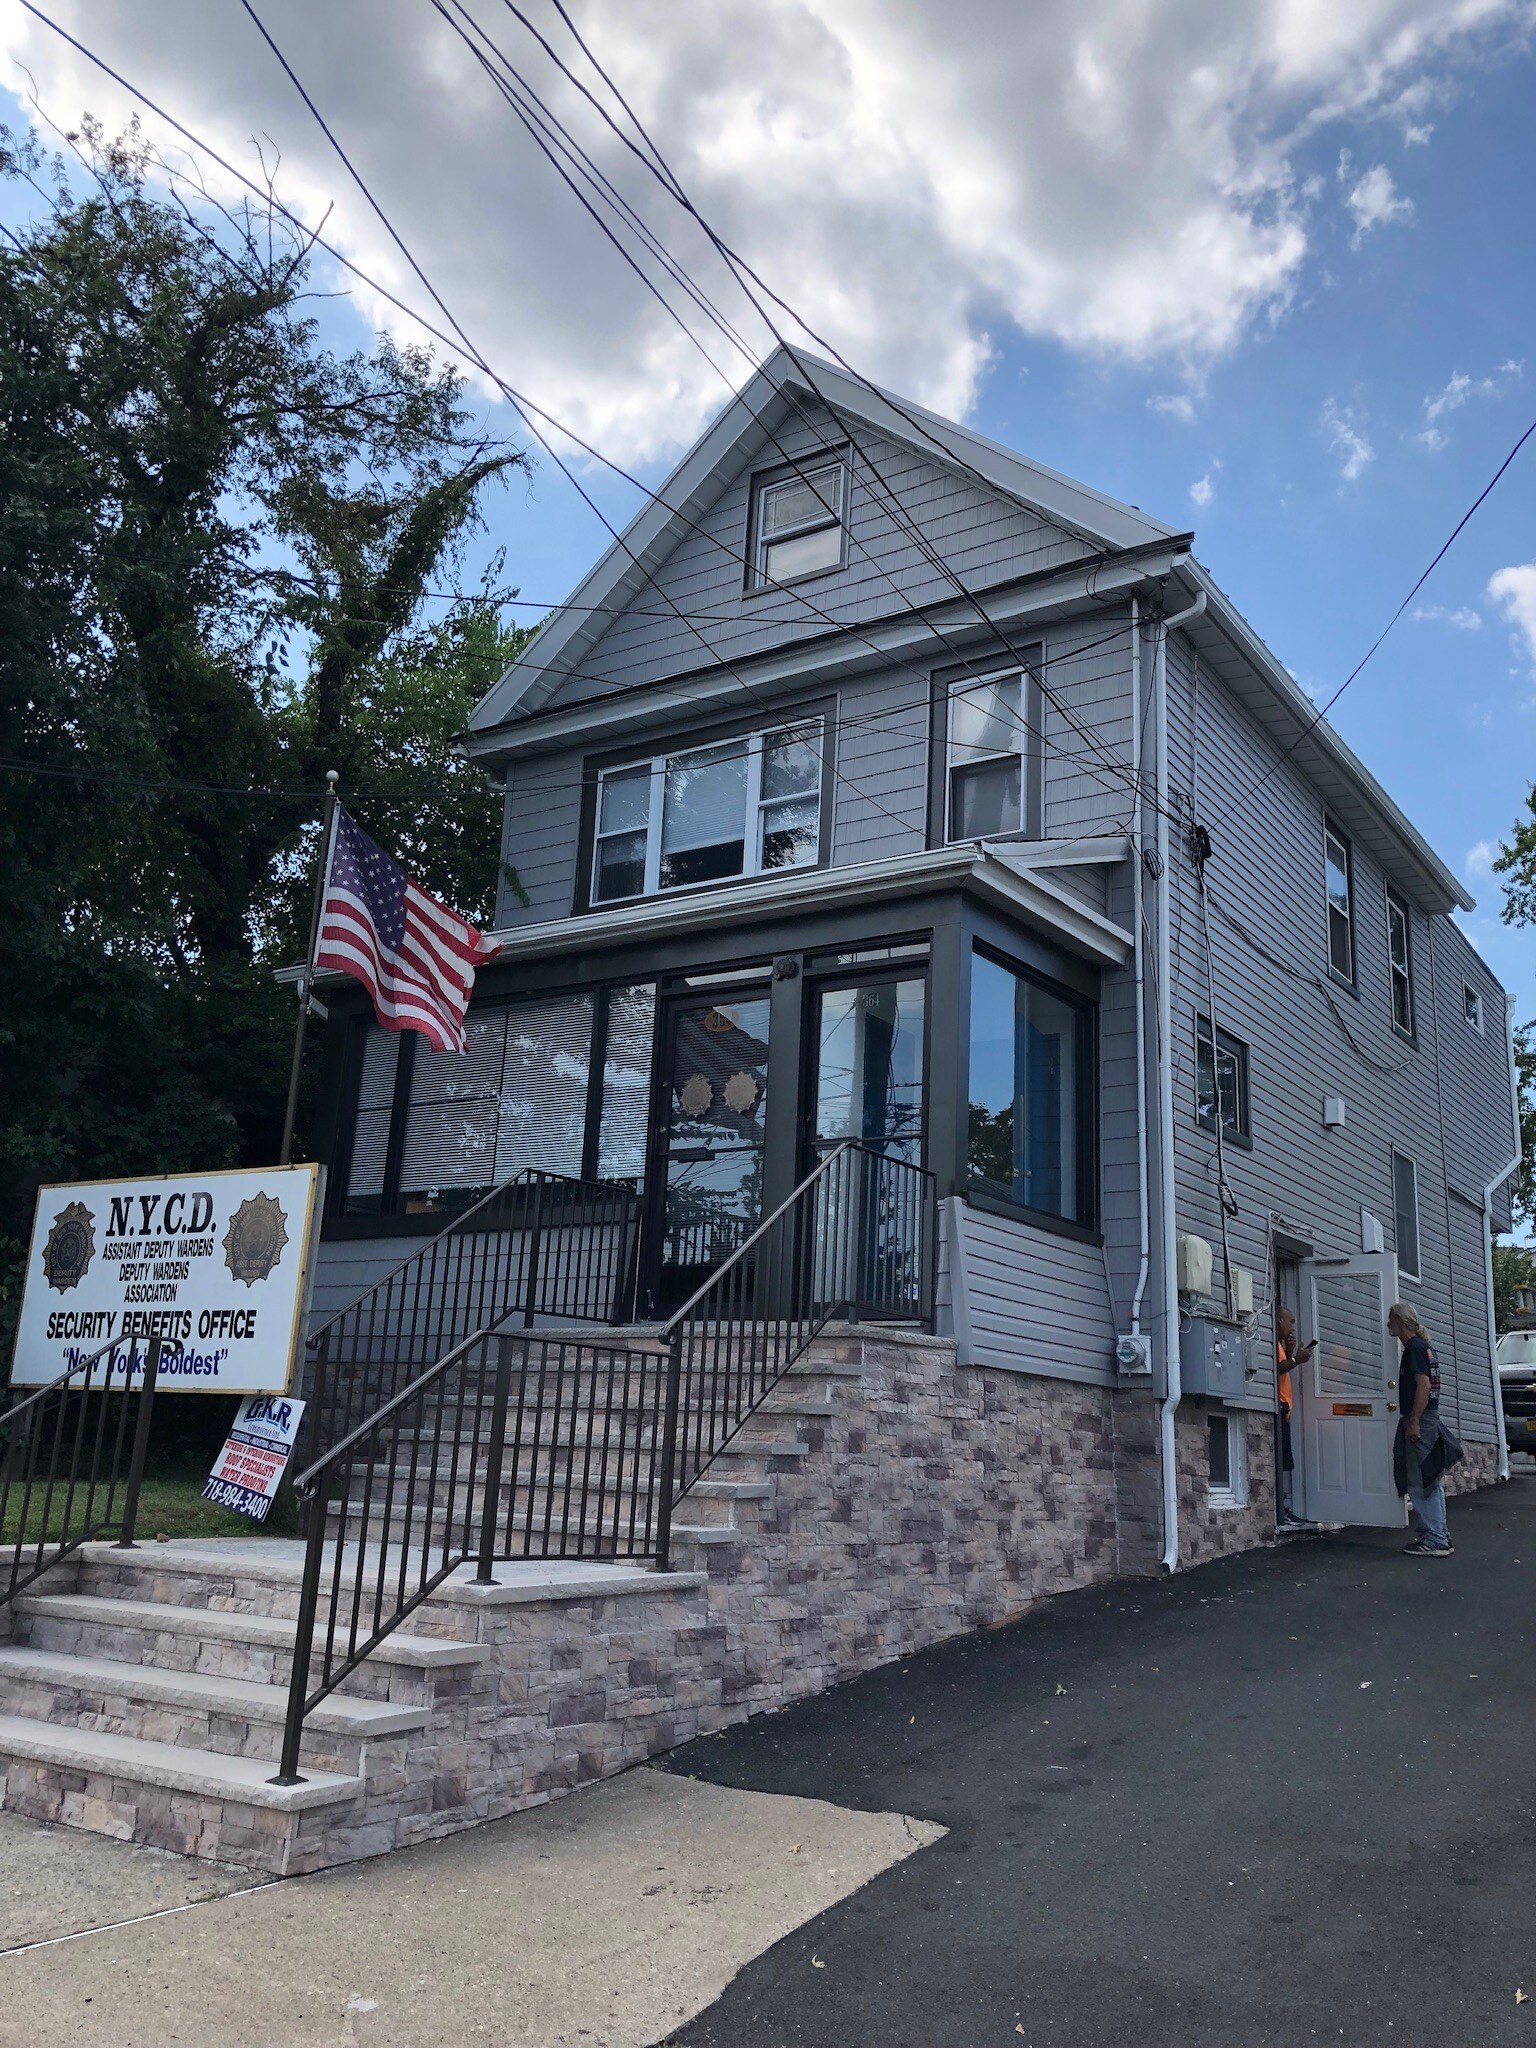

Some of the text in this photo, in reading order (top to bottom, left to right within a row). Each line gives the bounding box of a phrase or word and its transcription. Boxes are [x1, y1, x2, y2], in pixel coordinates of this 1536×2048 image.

[863, 992, 880, 1007] 364
[105, 1192, 216, 1236] N.Y.C.D.
[102, 1238, 214, 1260] ASSISTANT DEPUTY WARDENS
[54, 1269, 76, 1277] DEPUTY
[119, 1261, 189, 1281] DEPUTY WARDENS
[124, 1283, 178, 1303] ASSOCIATION
[47, 1309, 257, 1339] SECURITY BENEFITS OFFICE
[201, 1478, 268, 1519] 718-984-3400
